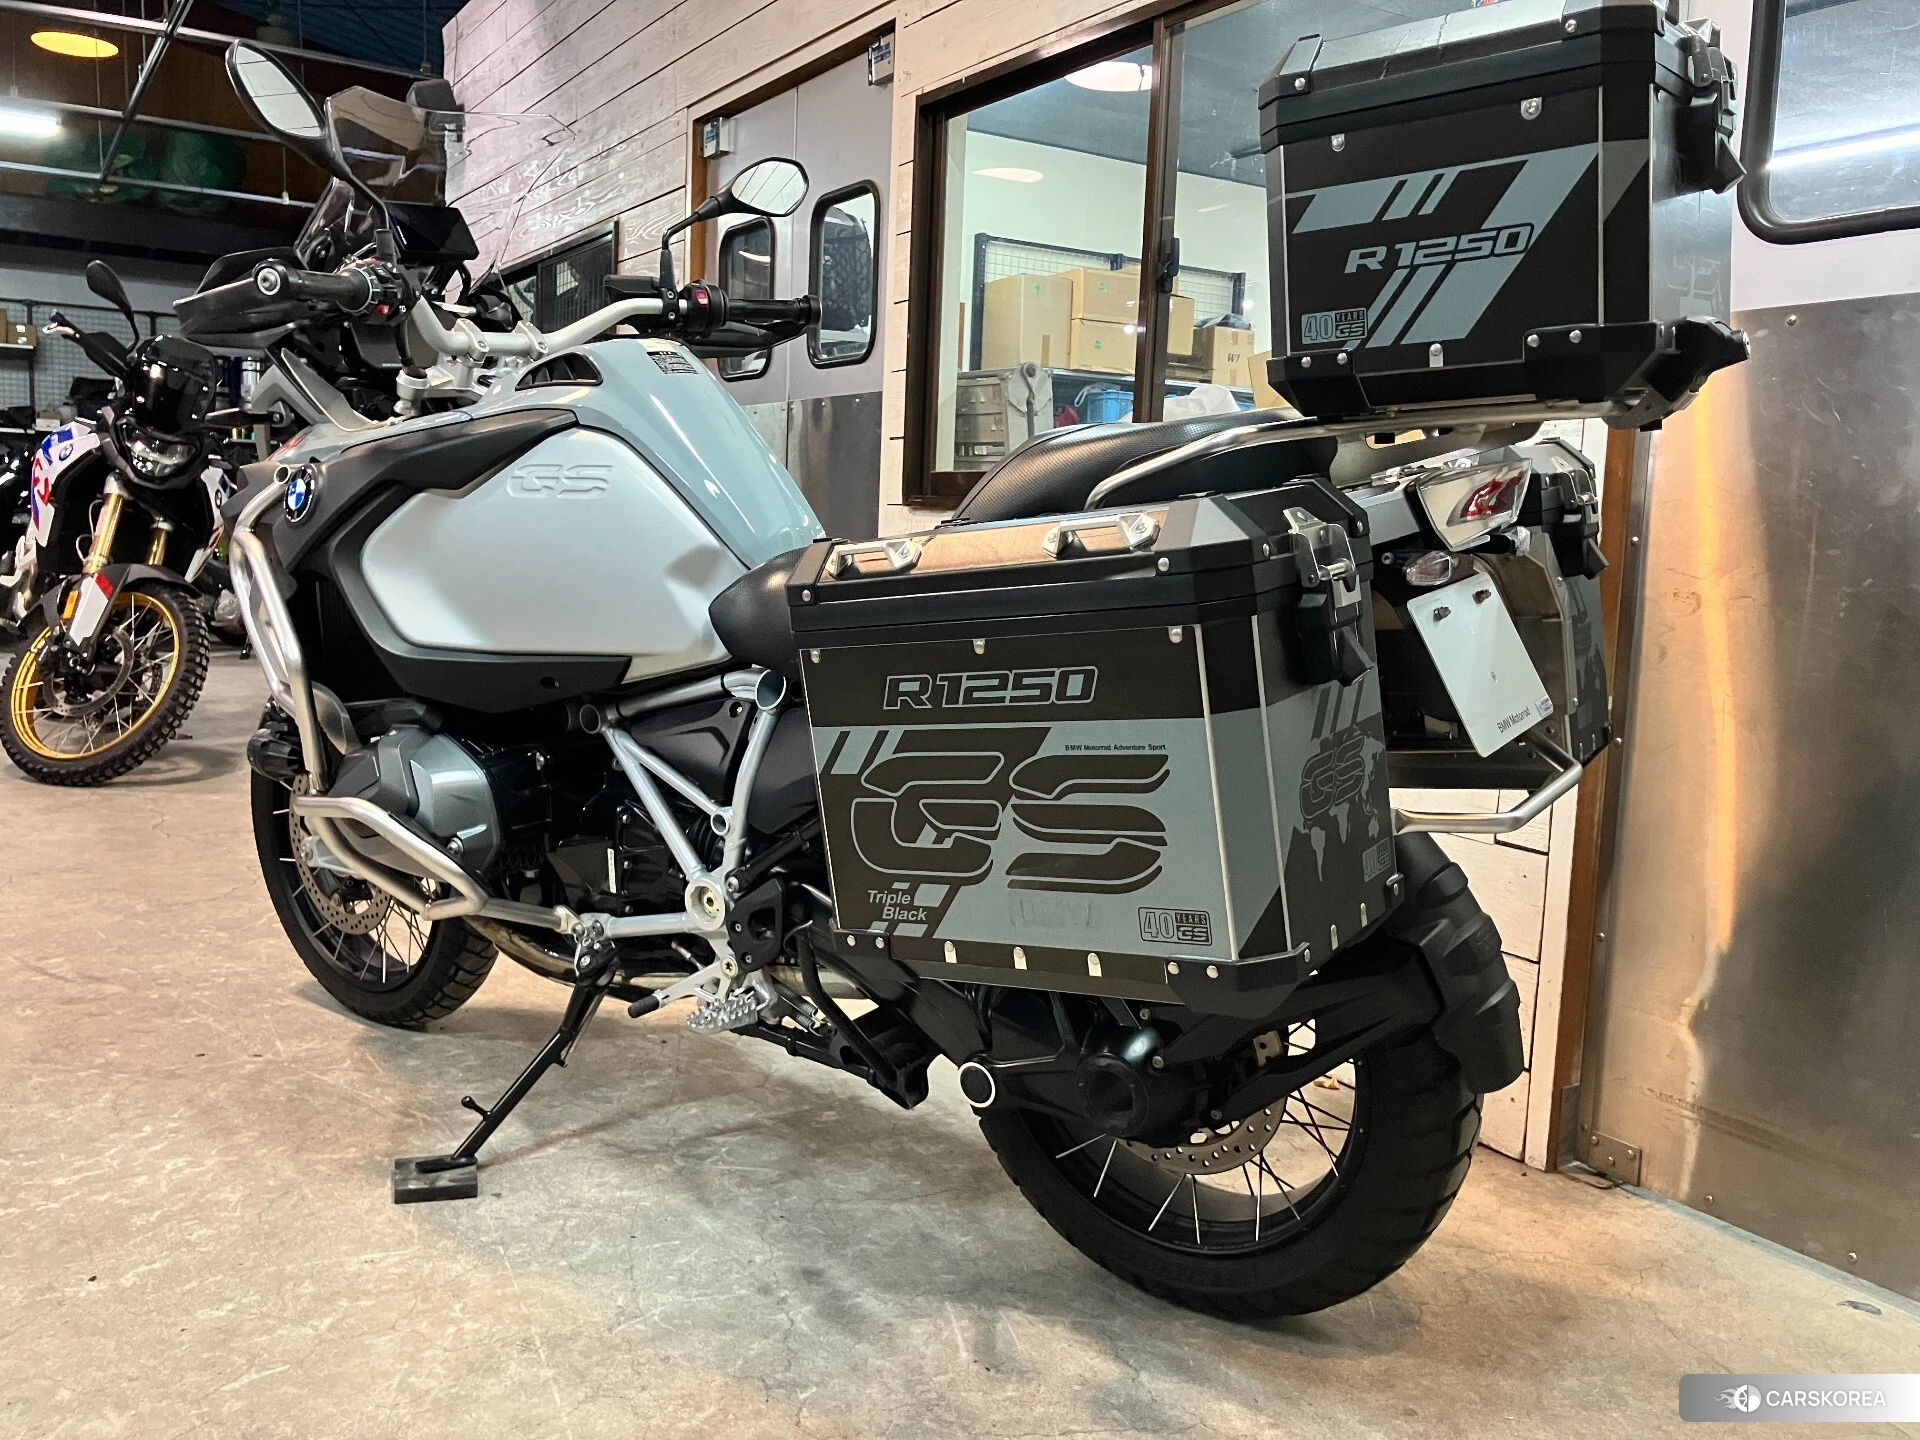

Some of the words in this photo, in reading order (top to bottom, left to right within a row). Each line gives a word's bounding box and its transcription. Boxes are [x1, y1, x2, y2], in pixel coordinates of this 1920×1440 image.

[1304, 315, 1333, 341] 40
[1335, 311, 1364, 322] YEARS
[506, 464, 612, 500] GS
[883, 665, 1098, 710] R1250
[1148, 743, 1166, 752] Sport
[1300, 735, 1365, 819] GS
[851, 752, 1171, 894] GS
[868, 890, 911, 907] Triple
[882, 906, 927, 921] Black
[1144, 911, 1175, 939] 40
[1175, 912, 1207, 925] YEARS
